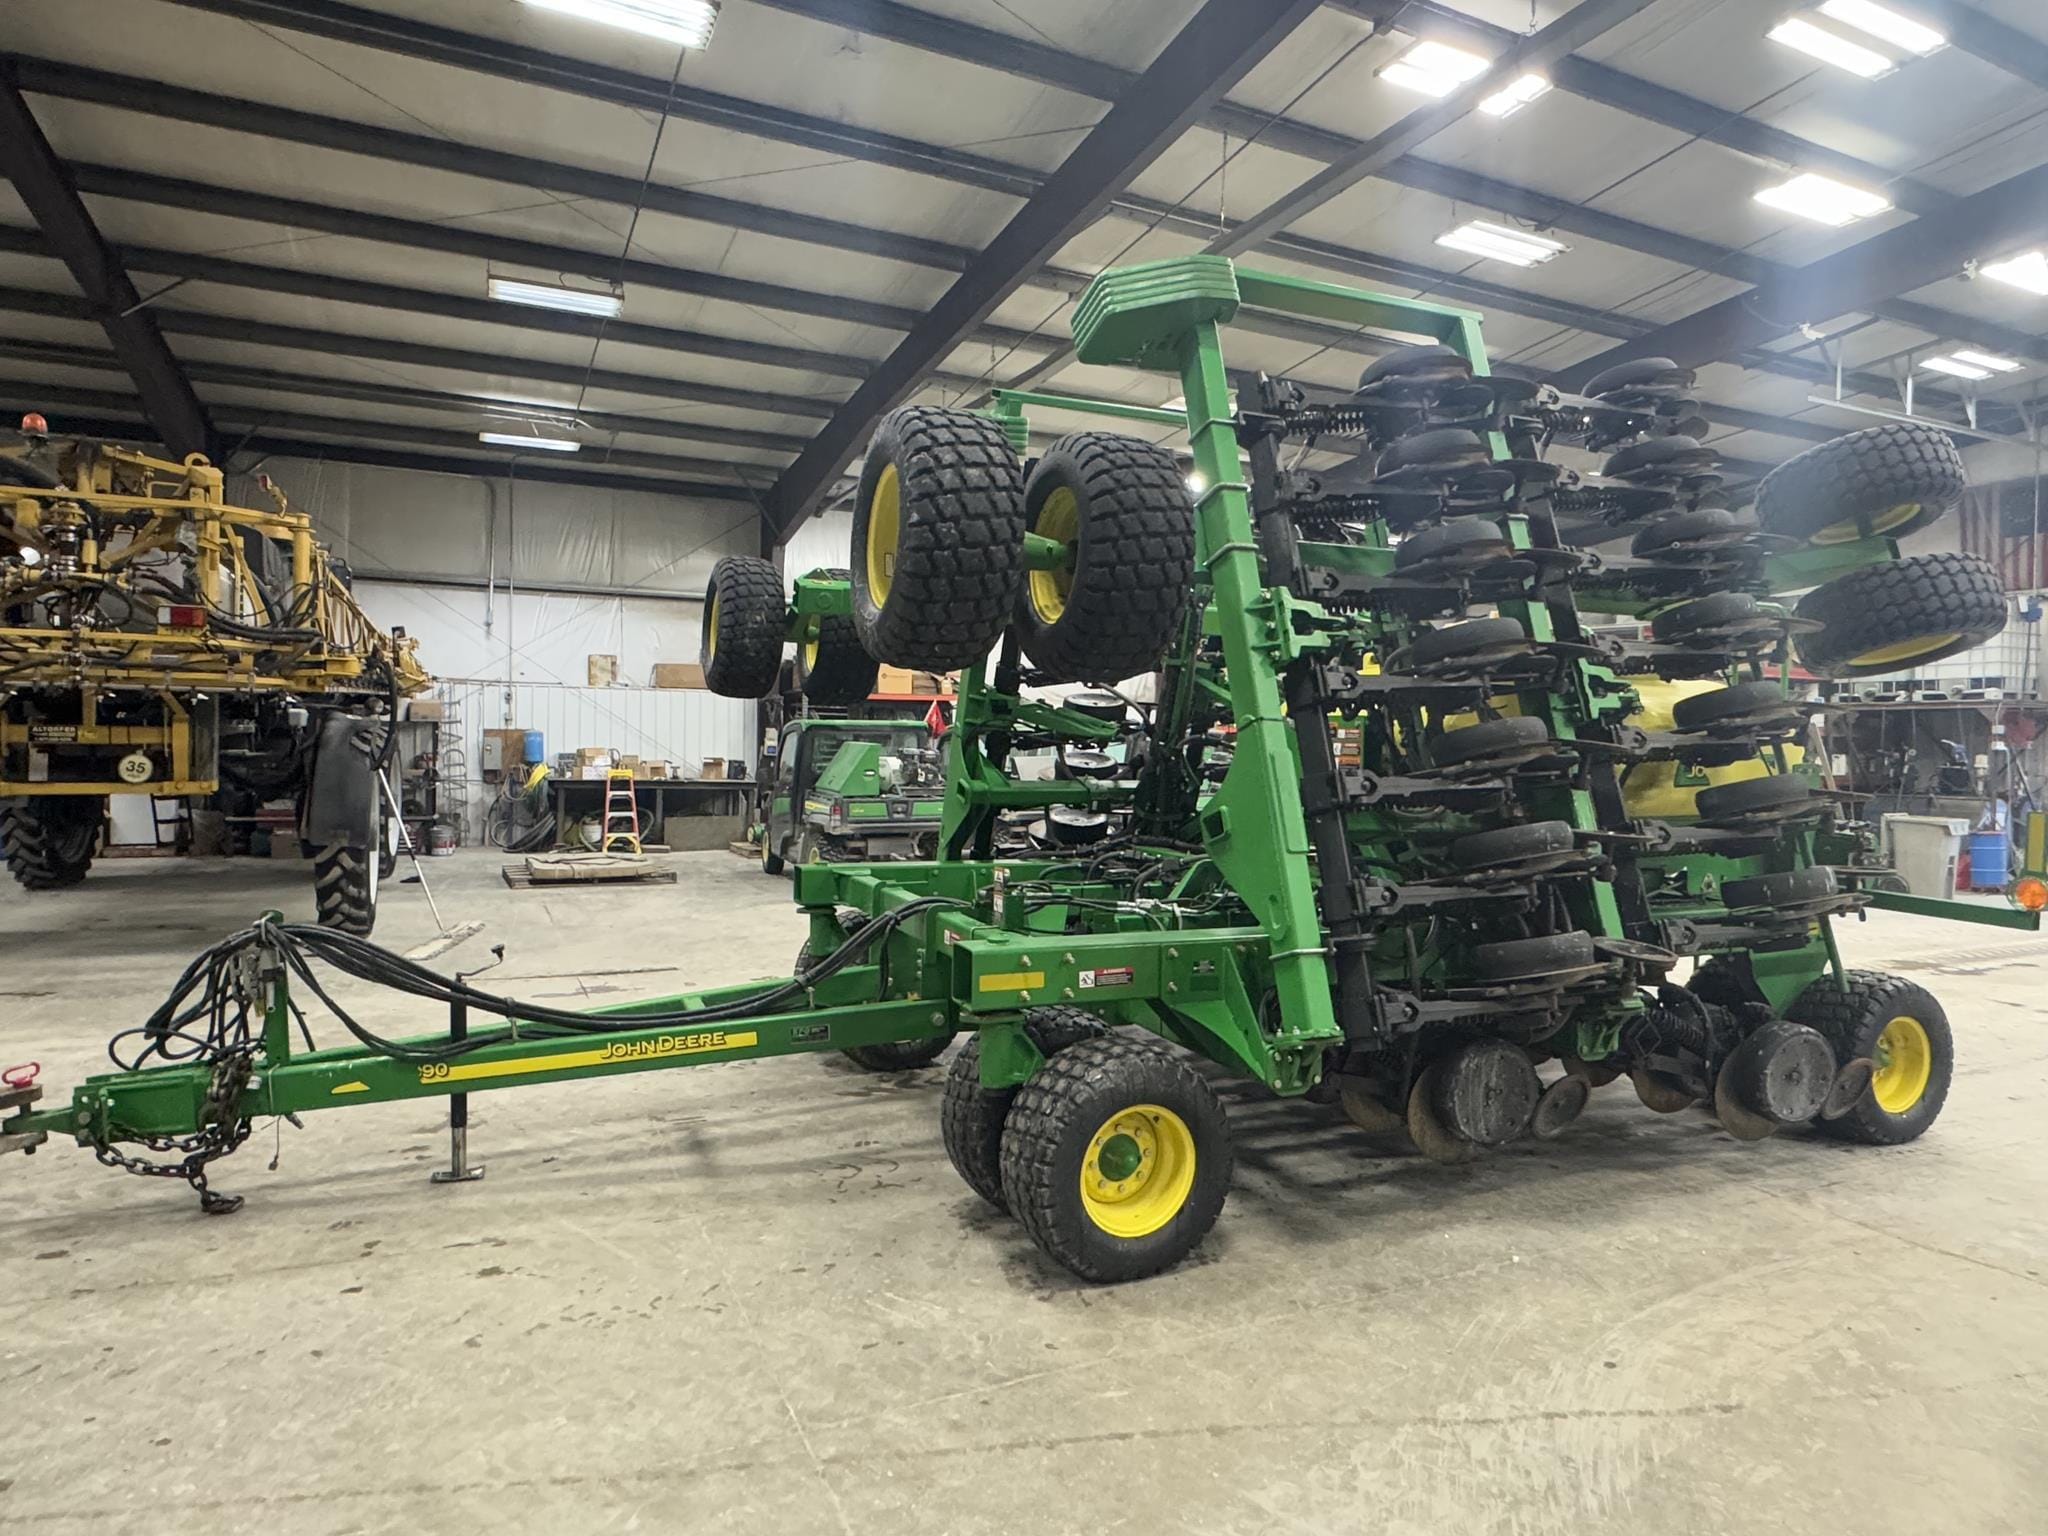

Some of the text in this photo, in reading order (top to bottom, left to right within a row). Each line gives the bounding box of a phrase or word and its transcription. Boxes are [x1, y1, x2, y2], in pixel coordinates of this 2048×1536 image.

[126, 760, 146, 774] 35
[600, 1031, 726, 1060] JOHN DEERE
[418, 1063, 449, 1078] 90
